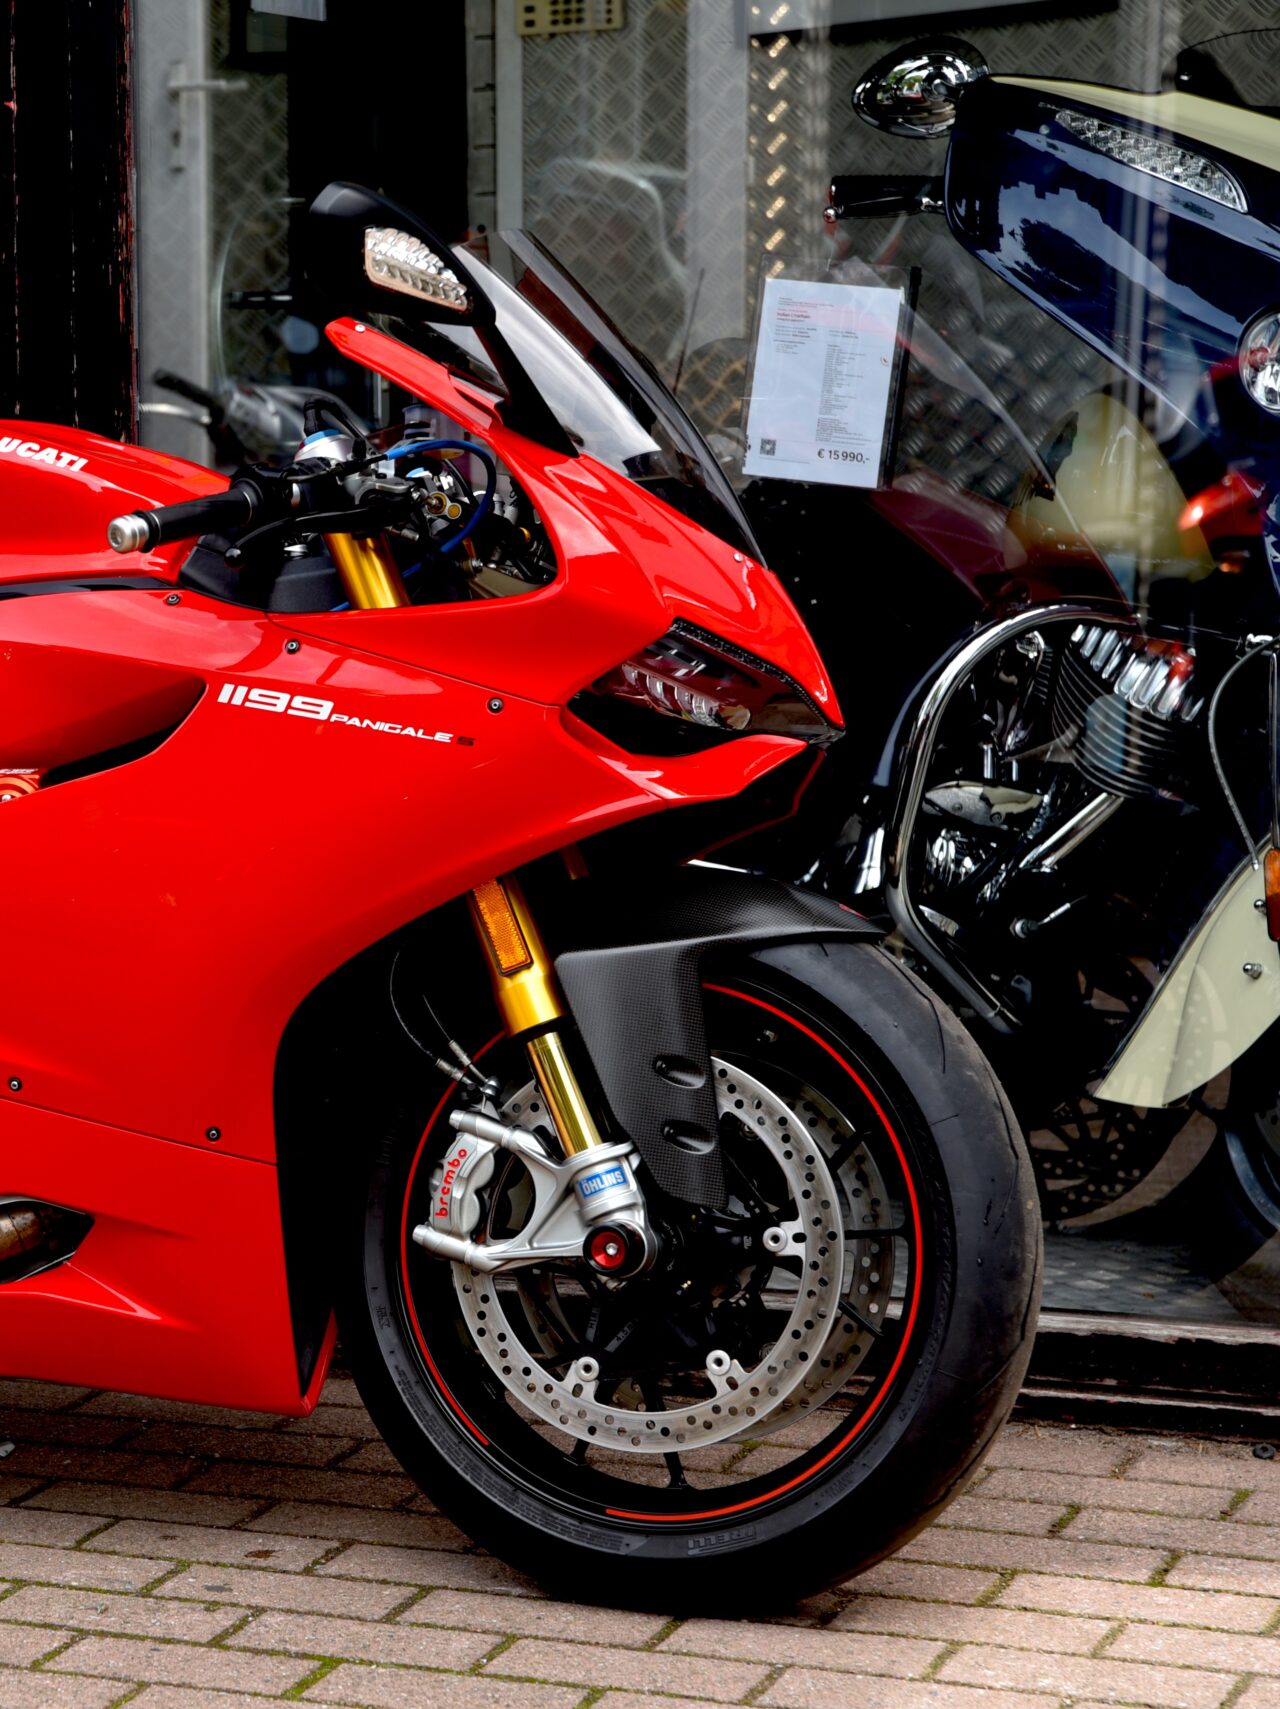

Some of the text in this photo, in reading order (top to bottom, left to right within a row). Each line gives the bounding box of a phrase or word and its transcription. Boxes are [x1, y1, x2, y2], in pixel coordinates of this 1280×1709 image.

[217, 683, 476, 746] 1199 PANIGALE S
[435, 1148, 467, 1219] brembo
[581, 1170, 624, 1196] ÖHLINS
